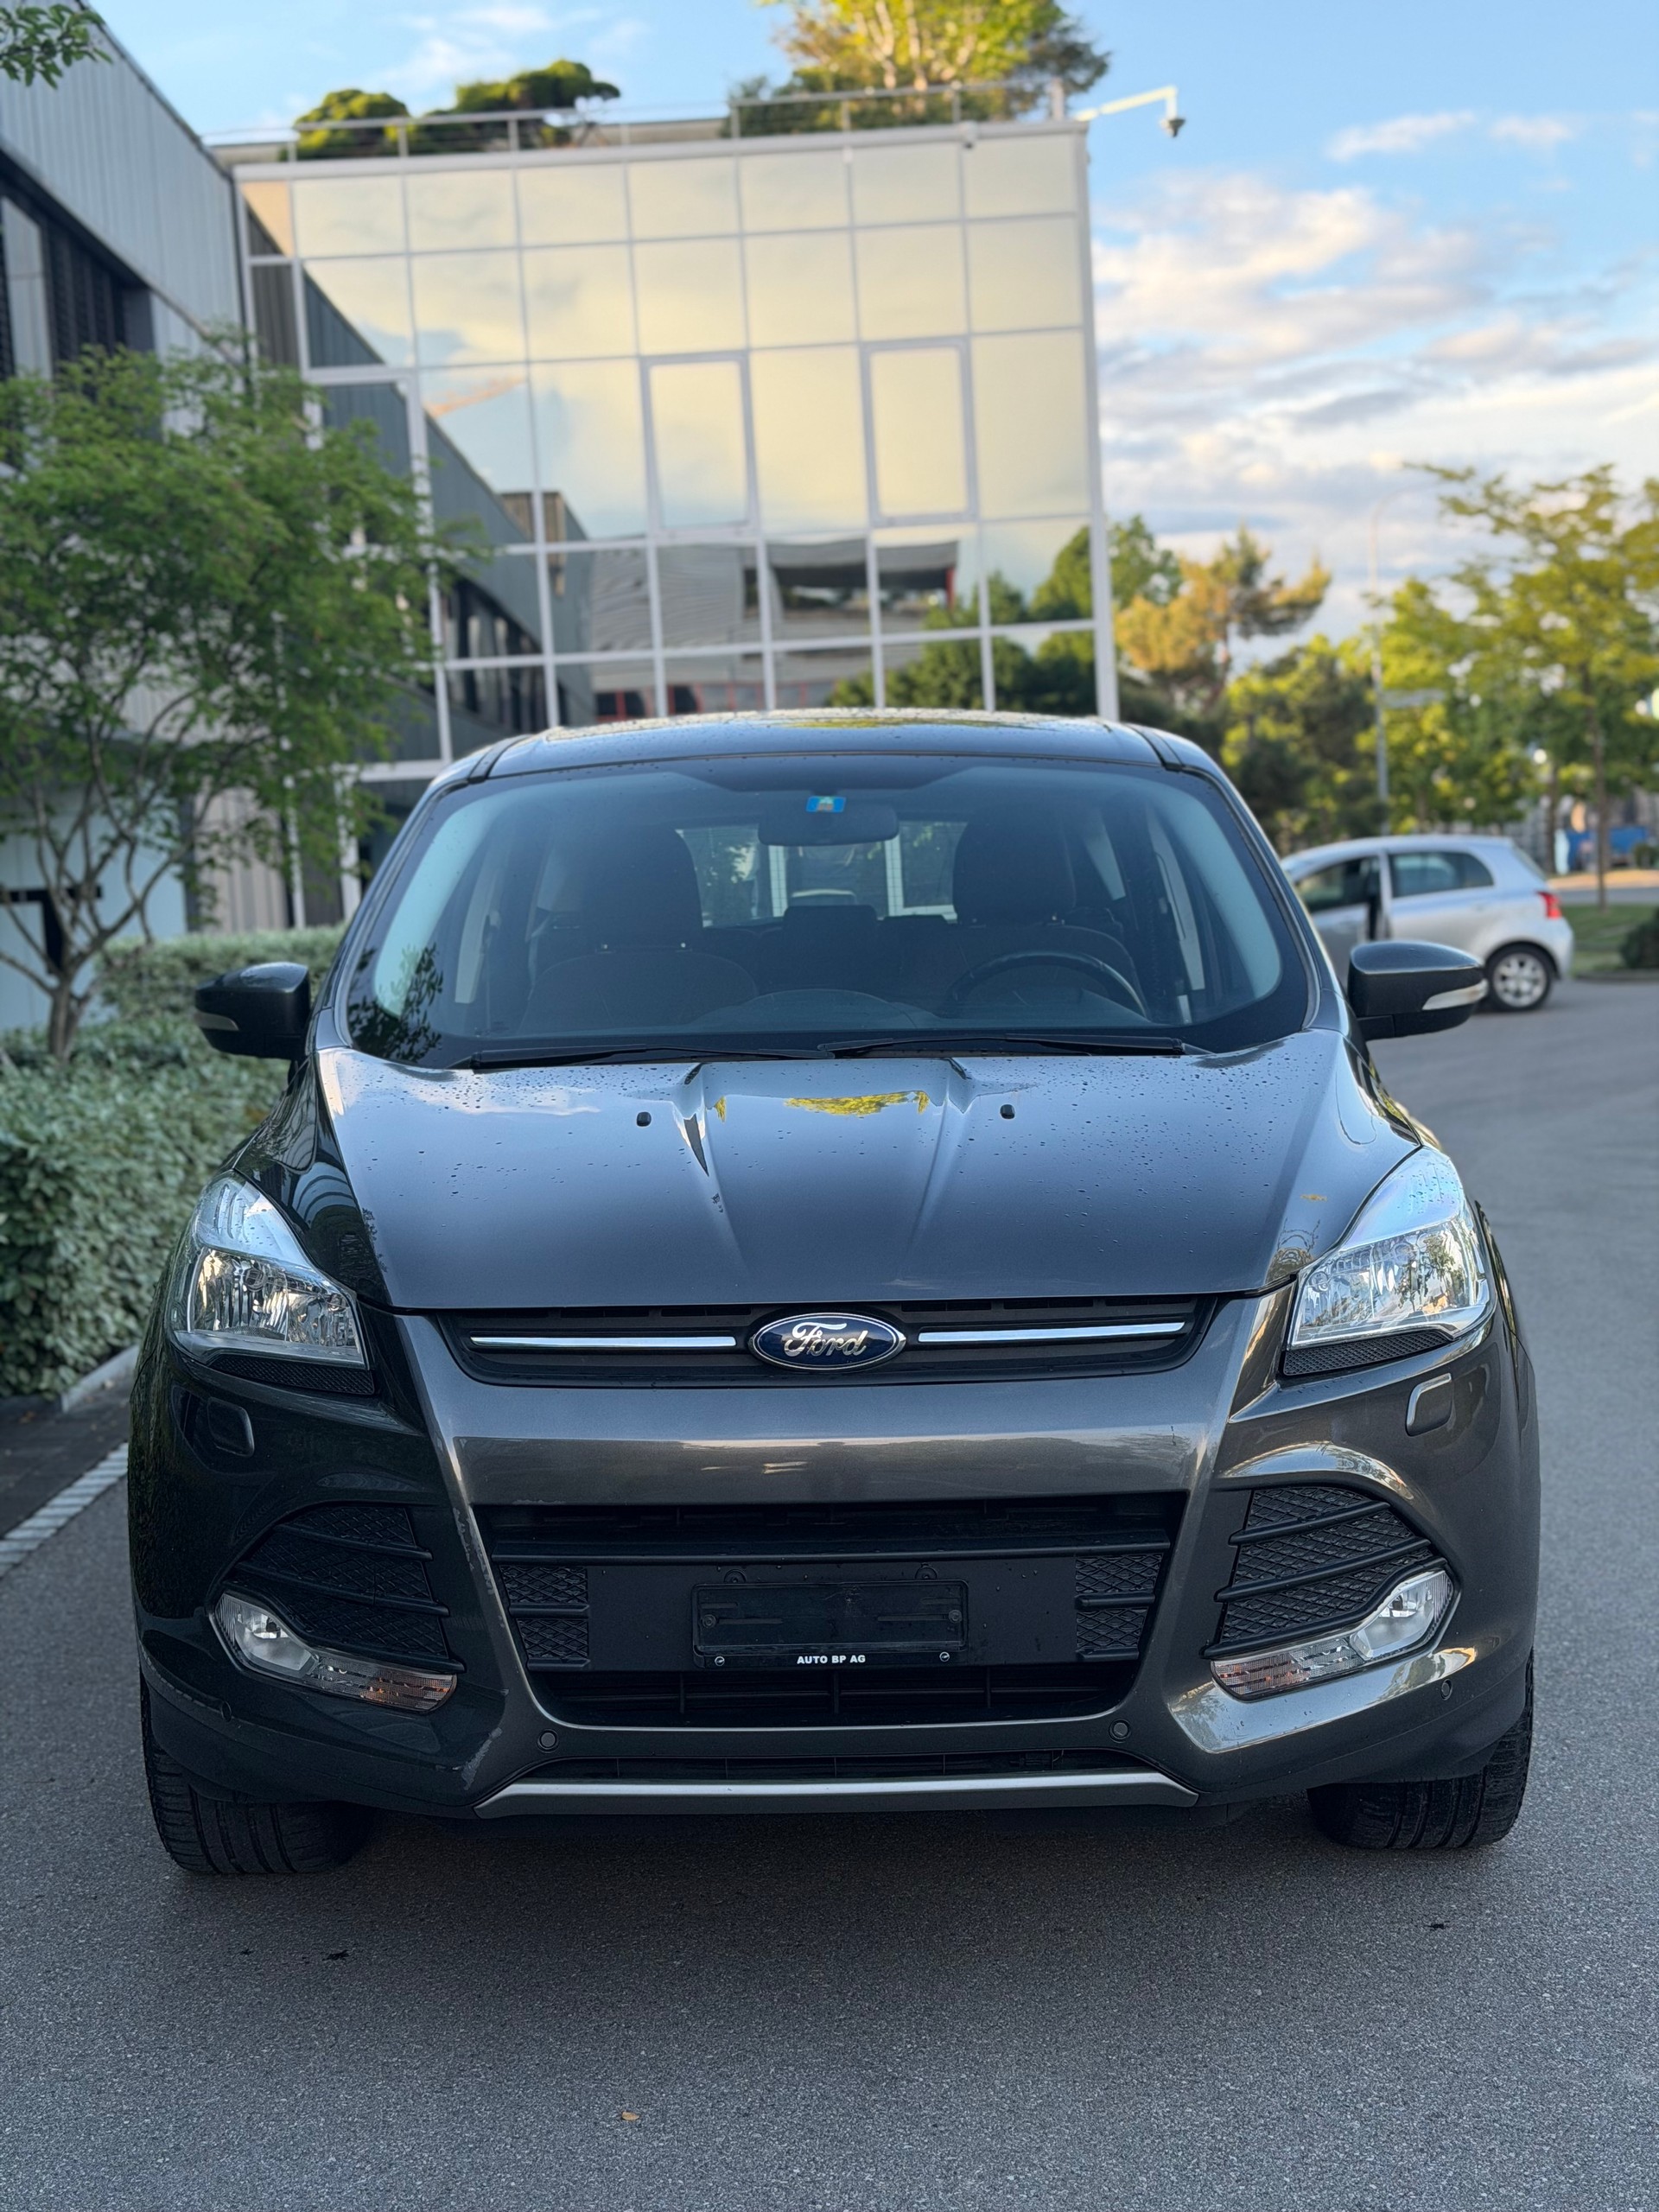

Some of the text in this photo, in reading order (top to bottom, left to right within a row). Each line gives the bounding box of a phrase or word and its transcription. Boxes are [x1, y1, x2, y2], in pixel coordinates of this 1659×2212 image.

[784, 1322, 868, 1357] Ford
[797, 1654, 866, 1664] AUTO BP AG
